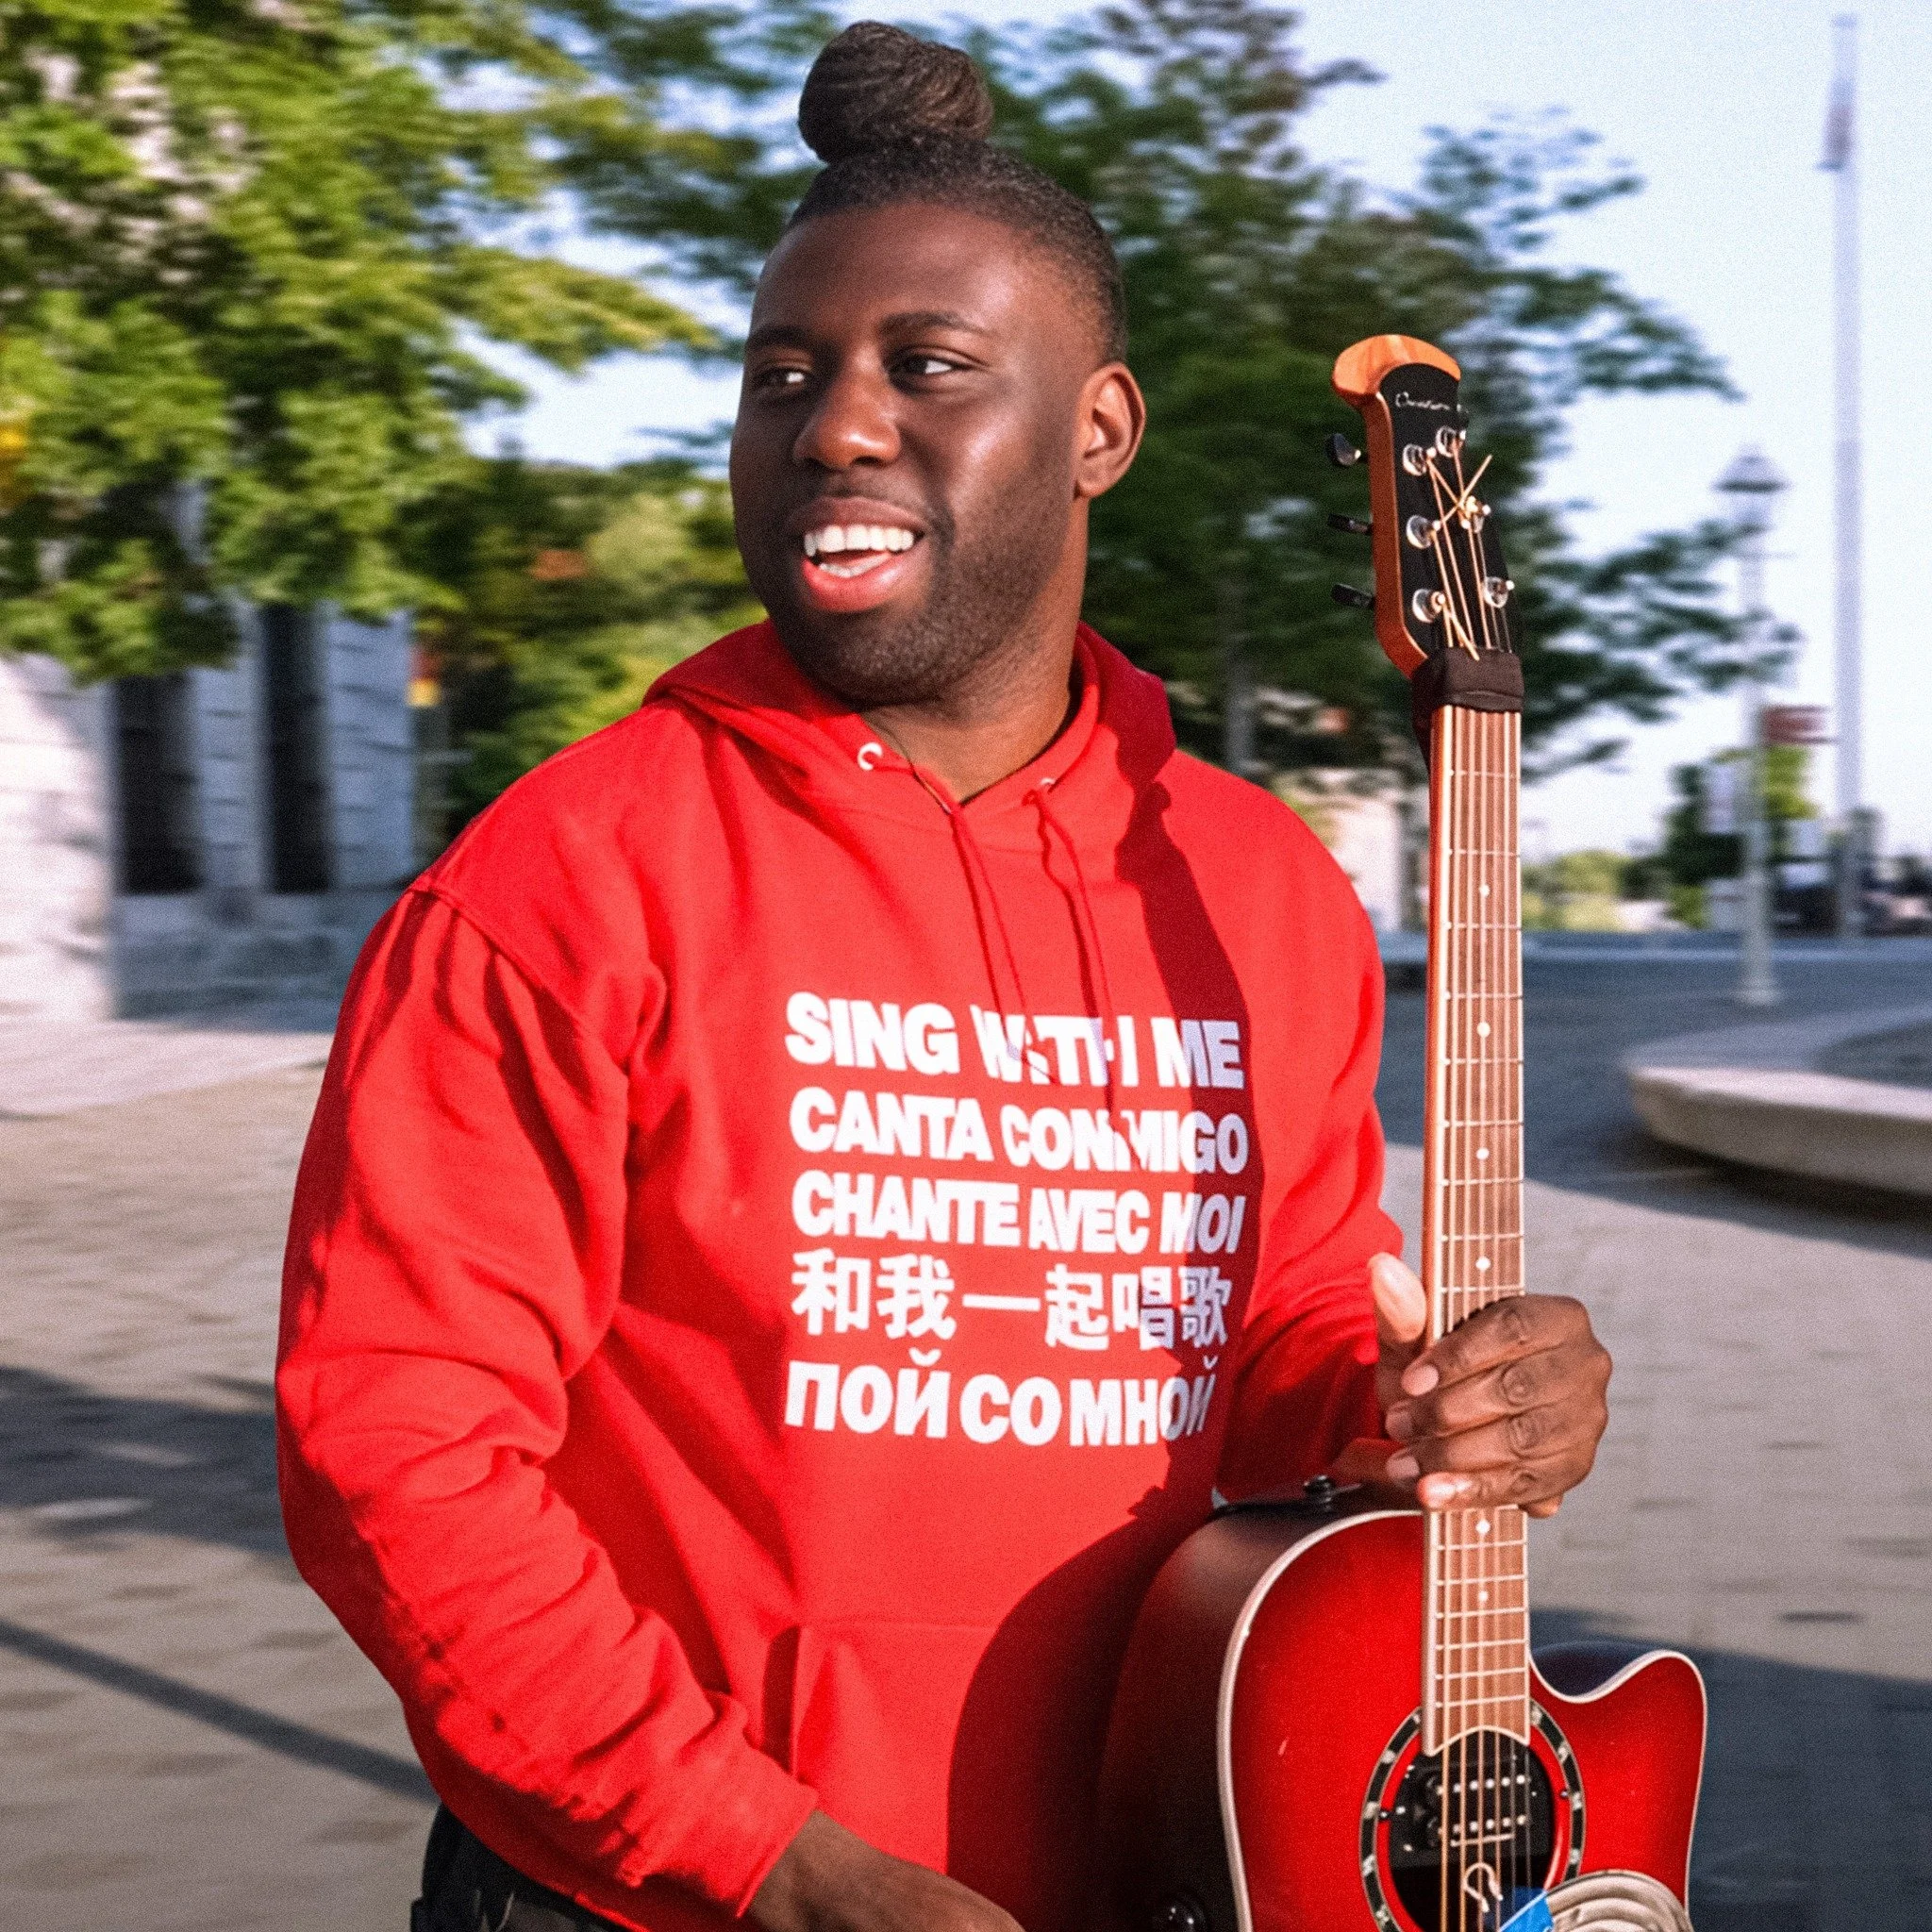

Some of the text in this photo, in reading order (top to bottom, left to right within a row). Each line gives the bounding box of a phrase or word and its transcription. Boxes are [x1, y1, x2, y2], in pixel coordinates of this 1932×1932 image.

[785, 991, 1245, 1090] SING WITH ME
[789, 1087, 1249, 1175] CANTA CONMIGO
[791, 1170, 1246, 1255] CHANTE AVEC MOI
[791, 1248, 1233, 1351] 和我一起唱歌
[784, 1347, 1219, 1447] ПОЙ СО МНОЙ
